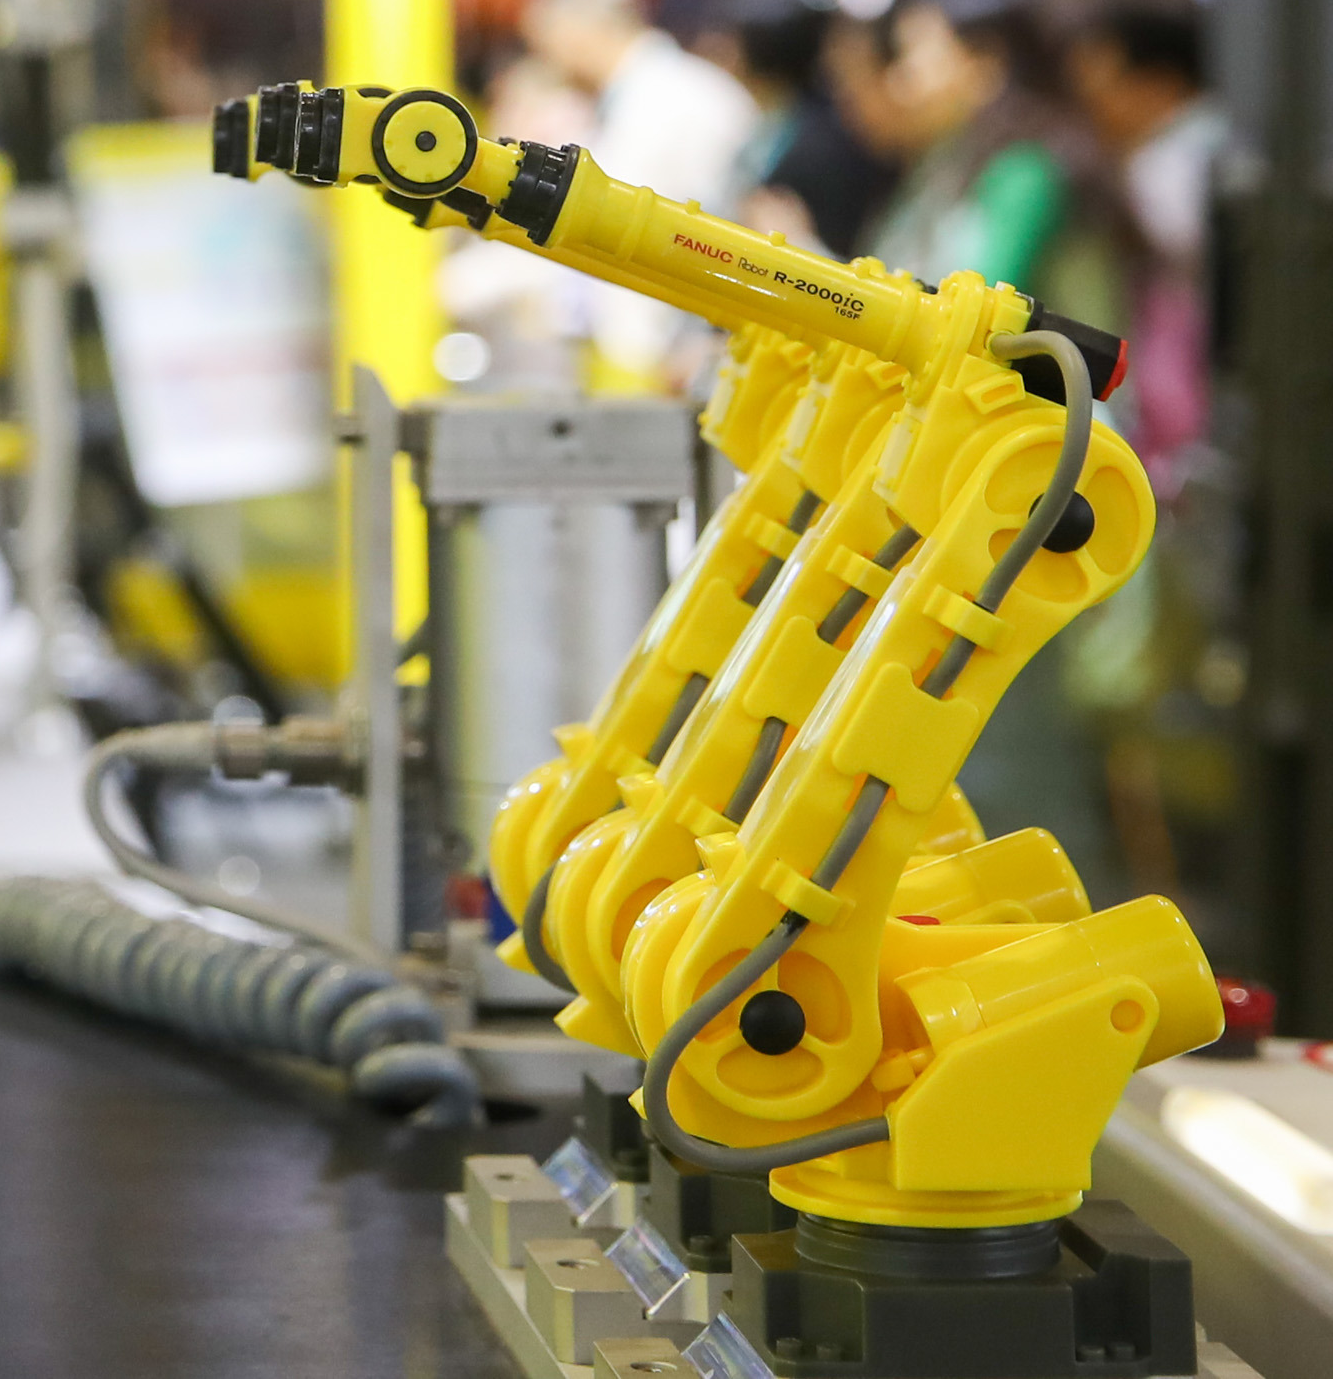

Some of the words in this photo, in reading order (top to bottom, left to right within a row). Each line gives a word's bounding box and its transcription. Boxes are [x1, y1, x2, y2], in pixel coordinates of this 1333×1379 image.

[673, 233, 733, 263] FANUC
[738, 256, 769, 278] Robot
[773, 270, 864, 313] R-2000iC
[835, 305, 860, 321] 165F
